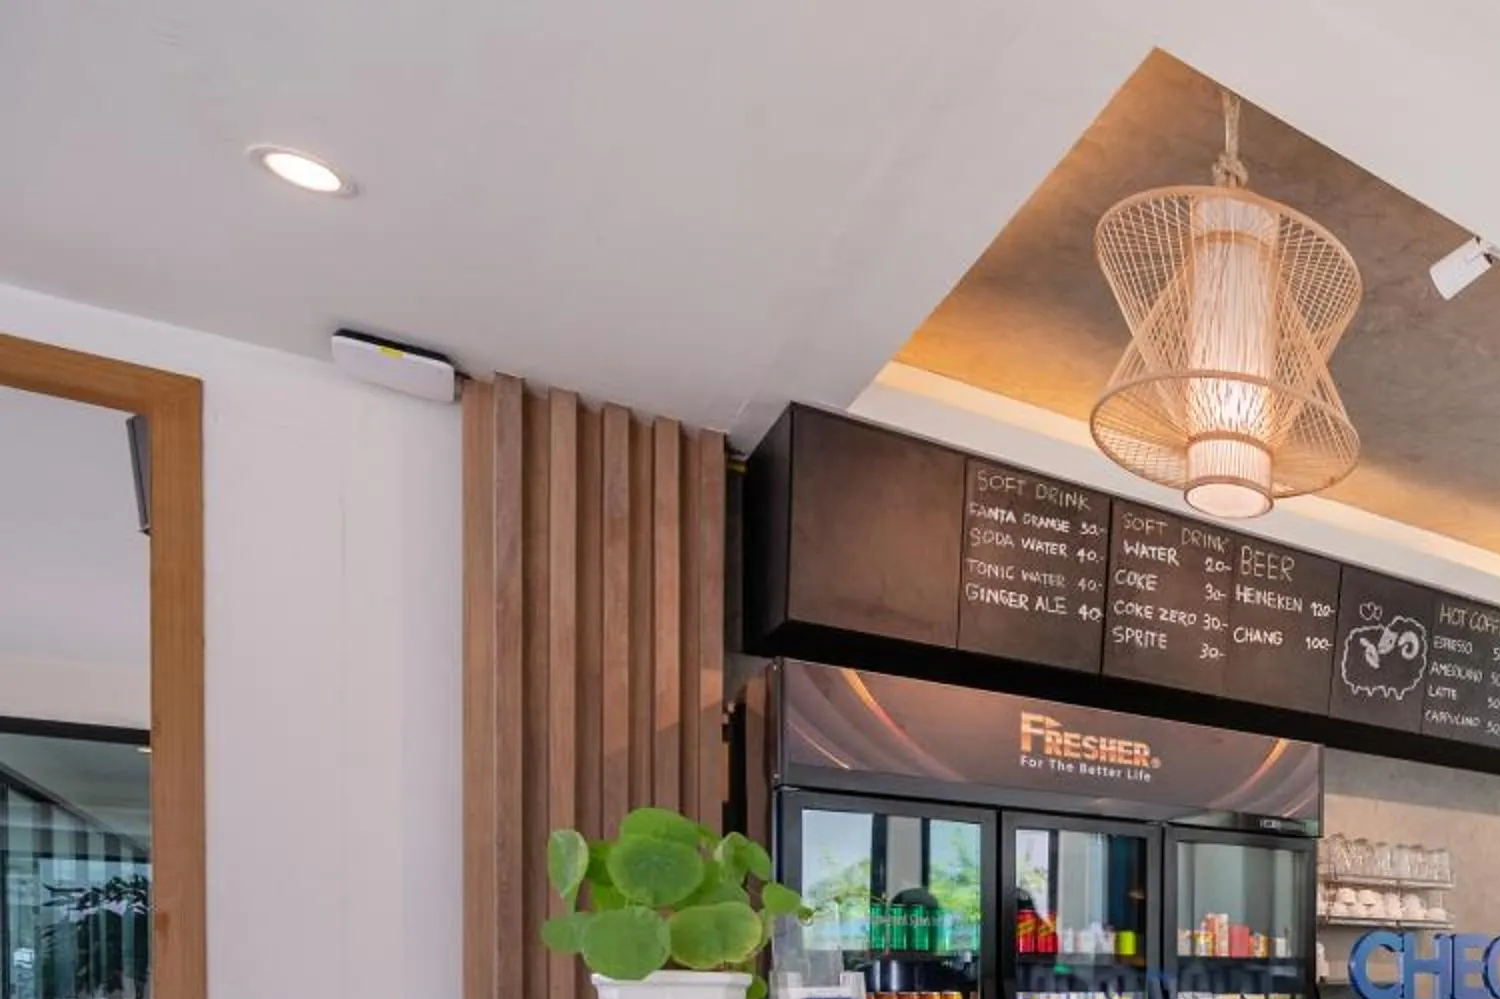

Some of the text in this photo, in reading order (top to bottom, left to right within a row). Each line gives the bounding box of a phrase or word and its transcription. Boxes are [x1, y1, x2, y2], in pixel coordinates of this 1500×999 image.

[977, 470, 1092, 511] SOFT DRINK
[969, 502, 1017, 525] FANTA
[969, 527, 1015, 548] SODA
[1021, 537, 1068, 557] WATER
[1122, 512, 1232, 553] SOFT DRINK
[1123, 540, 1180, 567] WATER
[1240, 545, 1296, 582] BEER
[966, 558, 1016, 581] TONIC
[1021, 569, 1066, 589] WATER
[1115, 569, 1158, 591] COKE
[965, 583, 1029, 611] GINGER
[1035, 596, 1069, 615] ALE
[1113, 601, 1153, 620] COKE
[1159, 608, 1197, 627] ZERO
[1440, 602, 1466, 627] HOT
[1112, 626, 1168, 649] SPRITE
[1233, 627, 1284, 646] CHANG
[1020, 755, 1152, 783] For The Better Life
